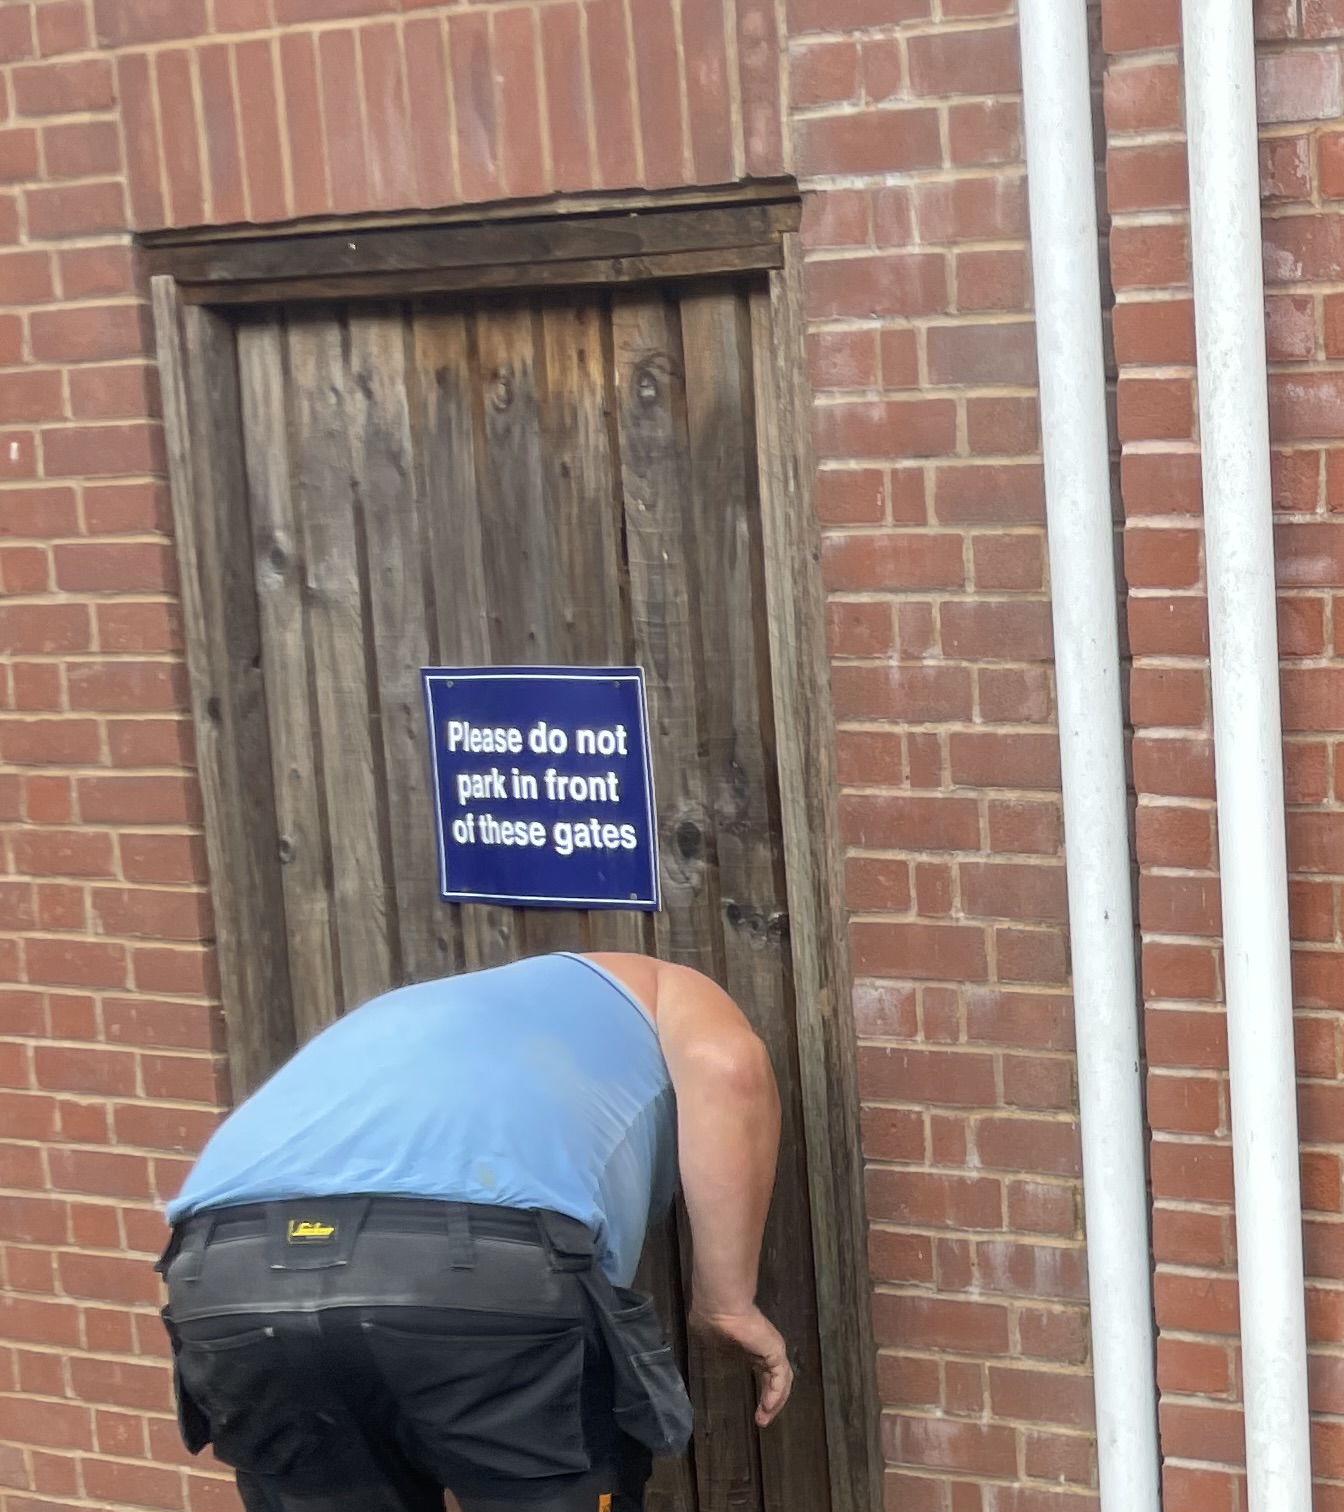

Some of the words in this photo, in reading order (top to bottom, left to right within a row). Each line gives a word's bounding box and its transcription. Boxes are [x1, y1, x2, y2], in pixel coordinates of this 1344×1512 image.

[448, 721, 523, 753] Please
[529, 722, 568, 754] do
[576, 724, 628, 755] not
[457, 768, 507, 805] park
[511, 768, 538, 799] in
[545, 768, 620, 802] front
[453, 813, 475, 844] of
[478, 814, 547, 847] these
[553, 818, 637, 855] gates
